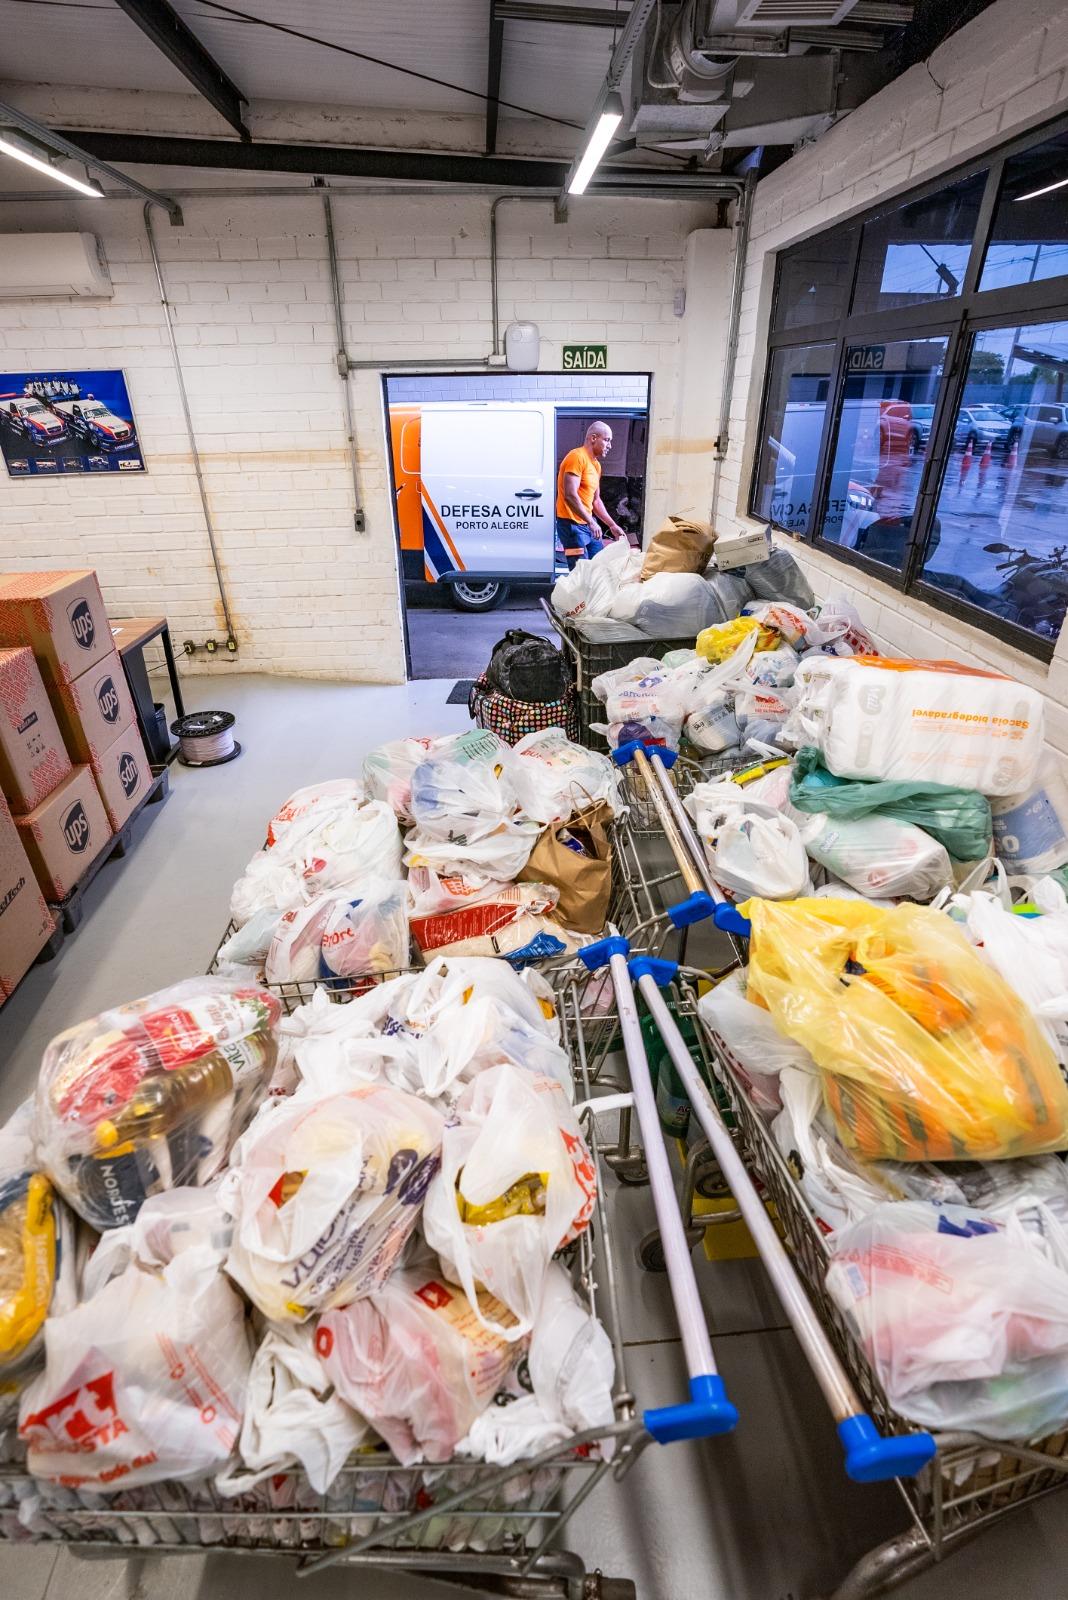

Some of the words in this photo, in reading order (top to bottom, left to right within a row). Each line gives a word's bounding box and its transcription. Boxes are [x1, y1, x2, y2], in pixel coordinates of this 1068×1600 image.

[563, 346, 606, 368] SAÍDA
[441, 505, 502, 517] DEFESA
[505, 505, 544, 517] CIVIL
[456, 521, 488, 530] PORTO
[490, 521, 529, 530] ALEGRE
[72, 611, 93, 643] ups
[99, 686, 118, 718] ups
[65, 813, 88, 845] ups
